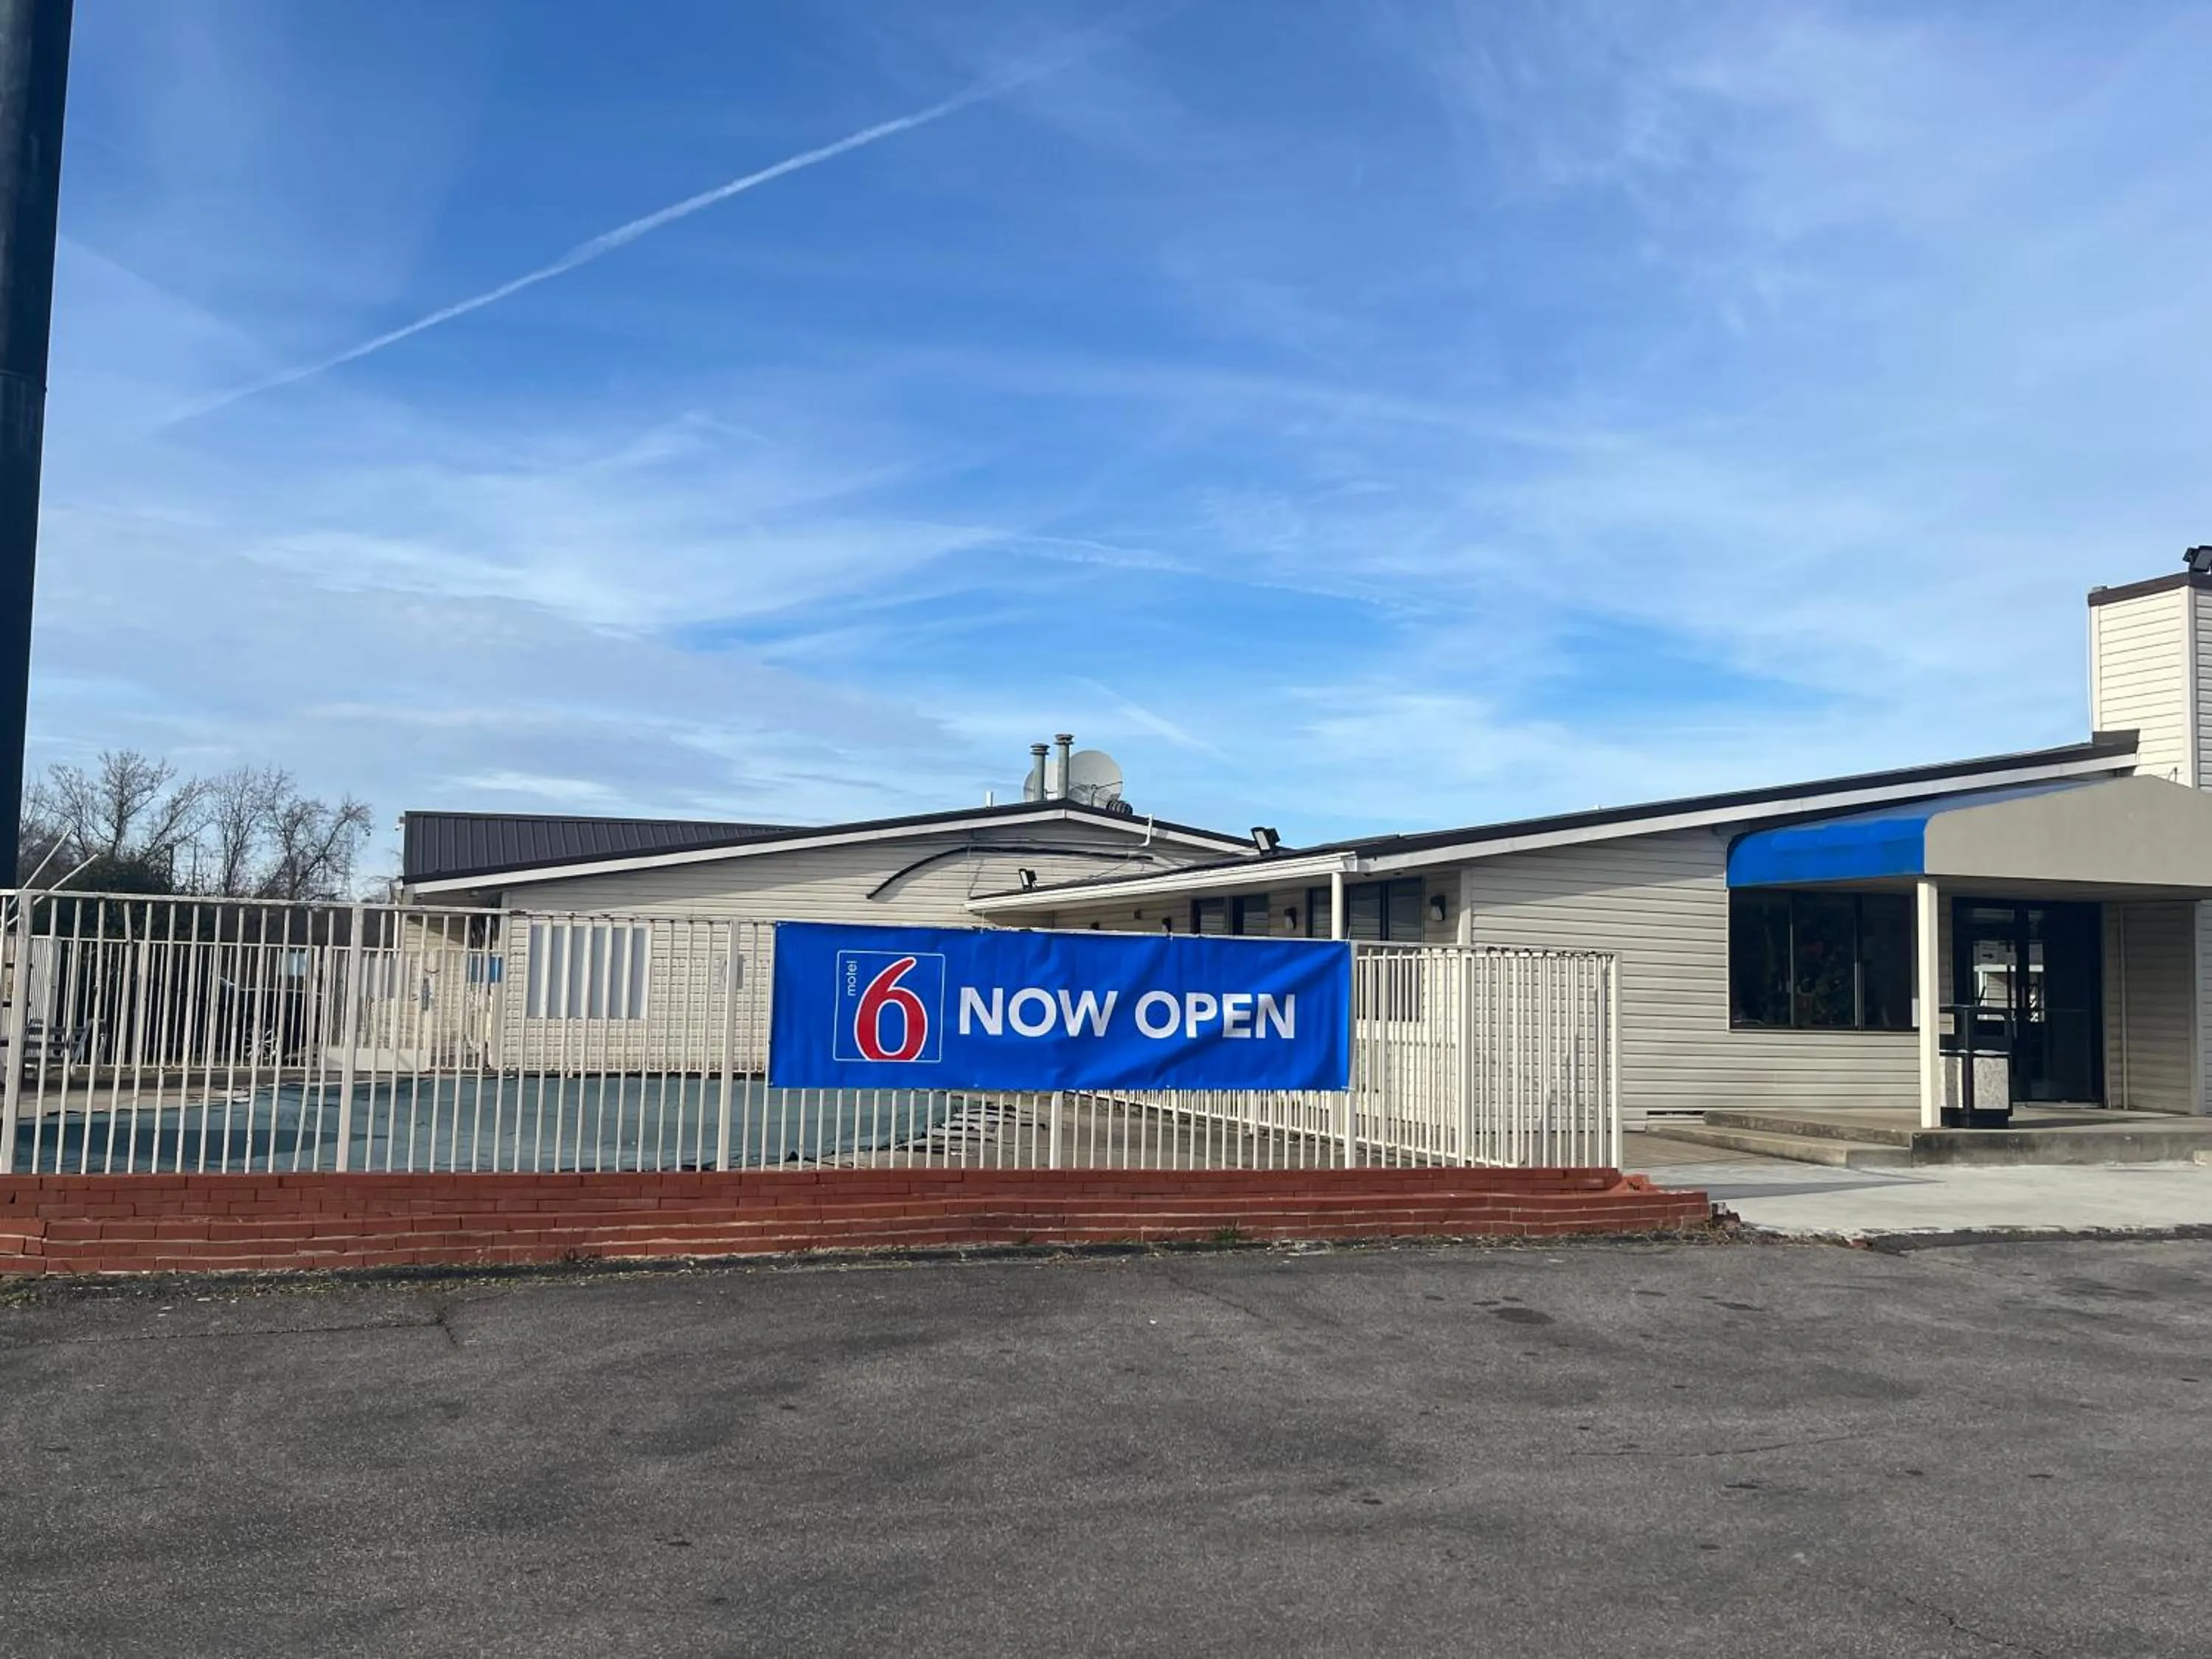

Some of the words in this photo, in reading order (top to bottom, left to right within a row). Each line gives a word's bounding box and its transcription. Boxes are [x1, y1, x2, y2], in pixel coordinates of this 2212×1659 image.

[846, 960, 858, 997] motel
[854, 956, 928, 1062] 6
[959, 987, 1118, 1037] NOW
[1135, 990, 1295, 1039] OPEN
